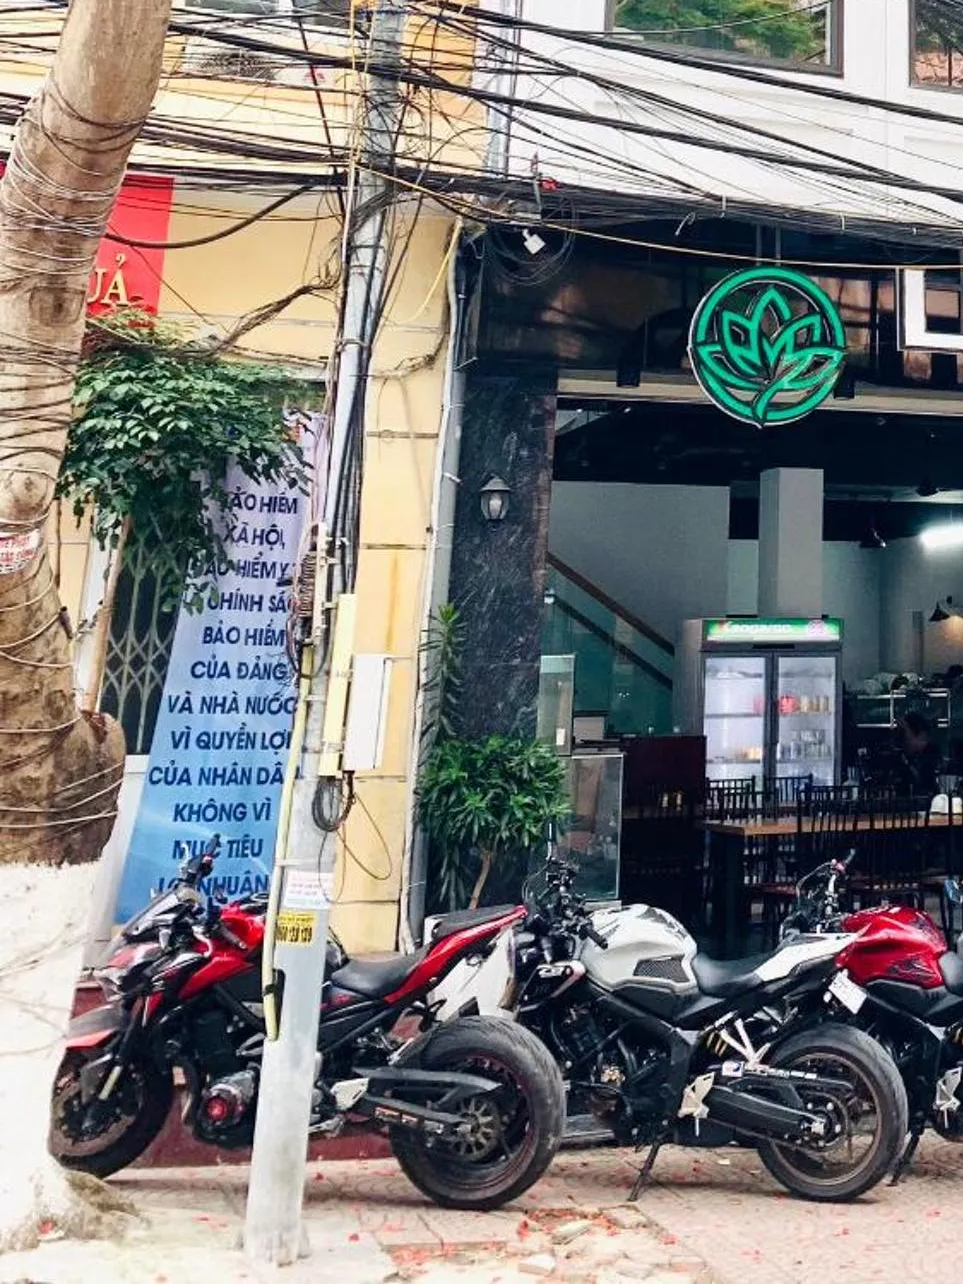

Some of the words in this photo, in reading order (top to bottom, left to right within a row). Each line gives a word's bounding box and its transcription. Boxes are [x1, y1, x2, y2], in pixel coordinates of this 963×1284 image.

[202, 619, 240, 644] BẢO
[190, 654, 231, 679] CỦA
[236, 655, 287, 680] ĐẢNG
[168, 690, 193, 714] VÀ
[199, 690, 240, 714] NHÀ
[245, 691, 298, 715] NƯỚC
[170, 725, 192, 750] VÌ
[195, 722, 256, 750] QUYỀN
[261, 729, 292, 755] LỢI
[149, 759, 192, 785] CỦA
[198, 762, 251, 786] NHÂN
[256, 762, 285, 785] DÂ
[172, 797, 247, 822] KHÔNG
[252, 797, 272, 820] VÌ
[227, 833, 263, 859] TIÊU
